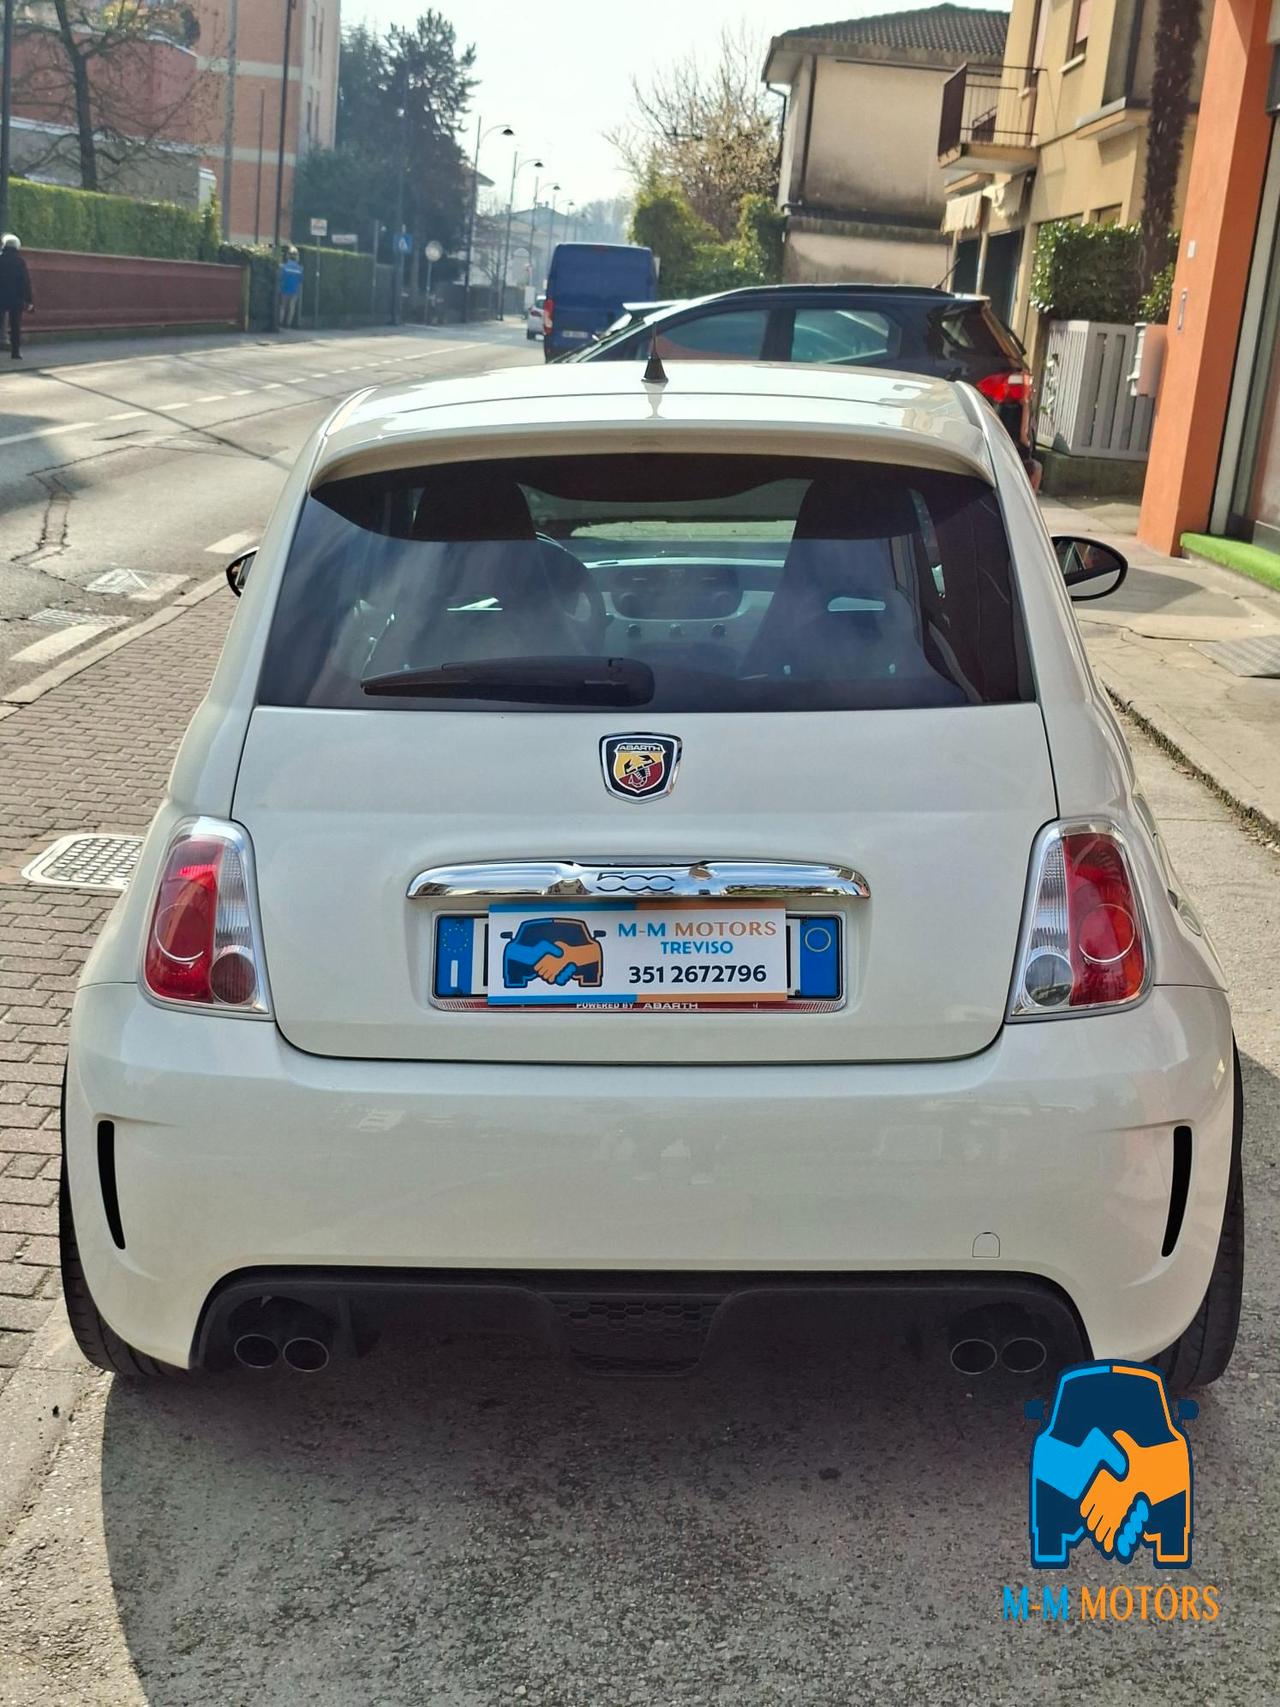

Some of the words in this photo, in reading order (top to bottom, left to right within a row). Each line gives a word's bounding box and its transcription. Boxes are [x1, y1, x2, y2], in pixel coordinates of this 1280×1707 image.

[596, 872, 675, 892] 500
[618, 922, 666, 937] M-M
[675, 921, 777, 937] MOTORS
[661, 940, 733, 954] TREVISO
[629, 966, 664, 983] 351
[671, 965, 767, 983] 2672796
[643, 1002, 699, 1010] ABARTH
